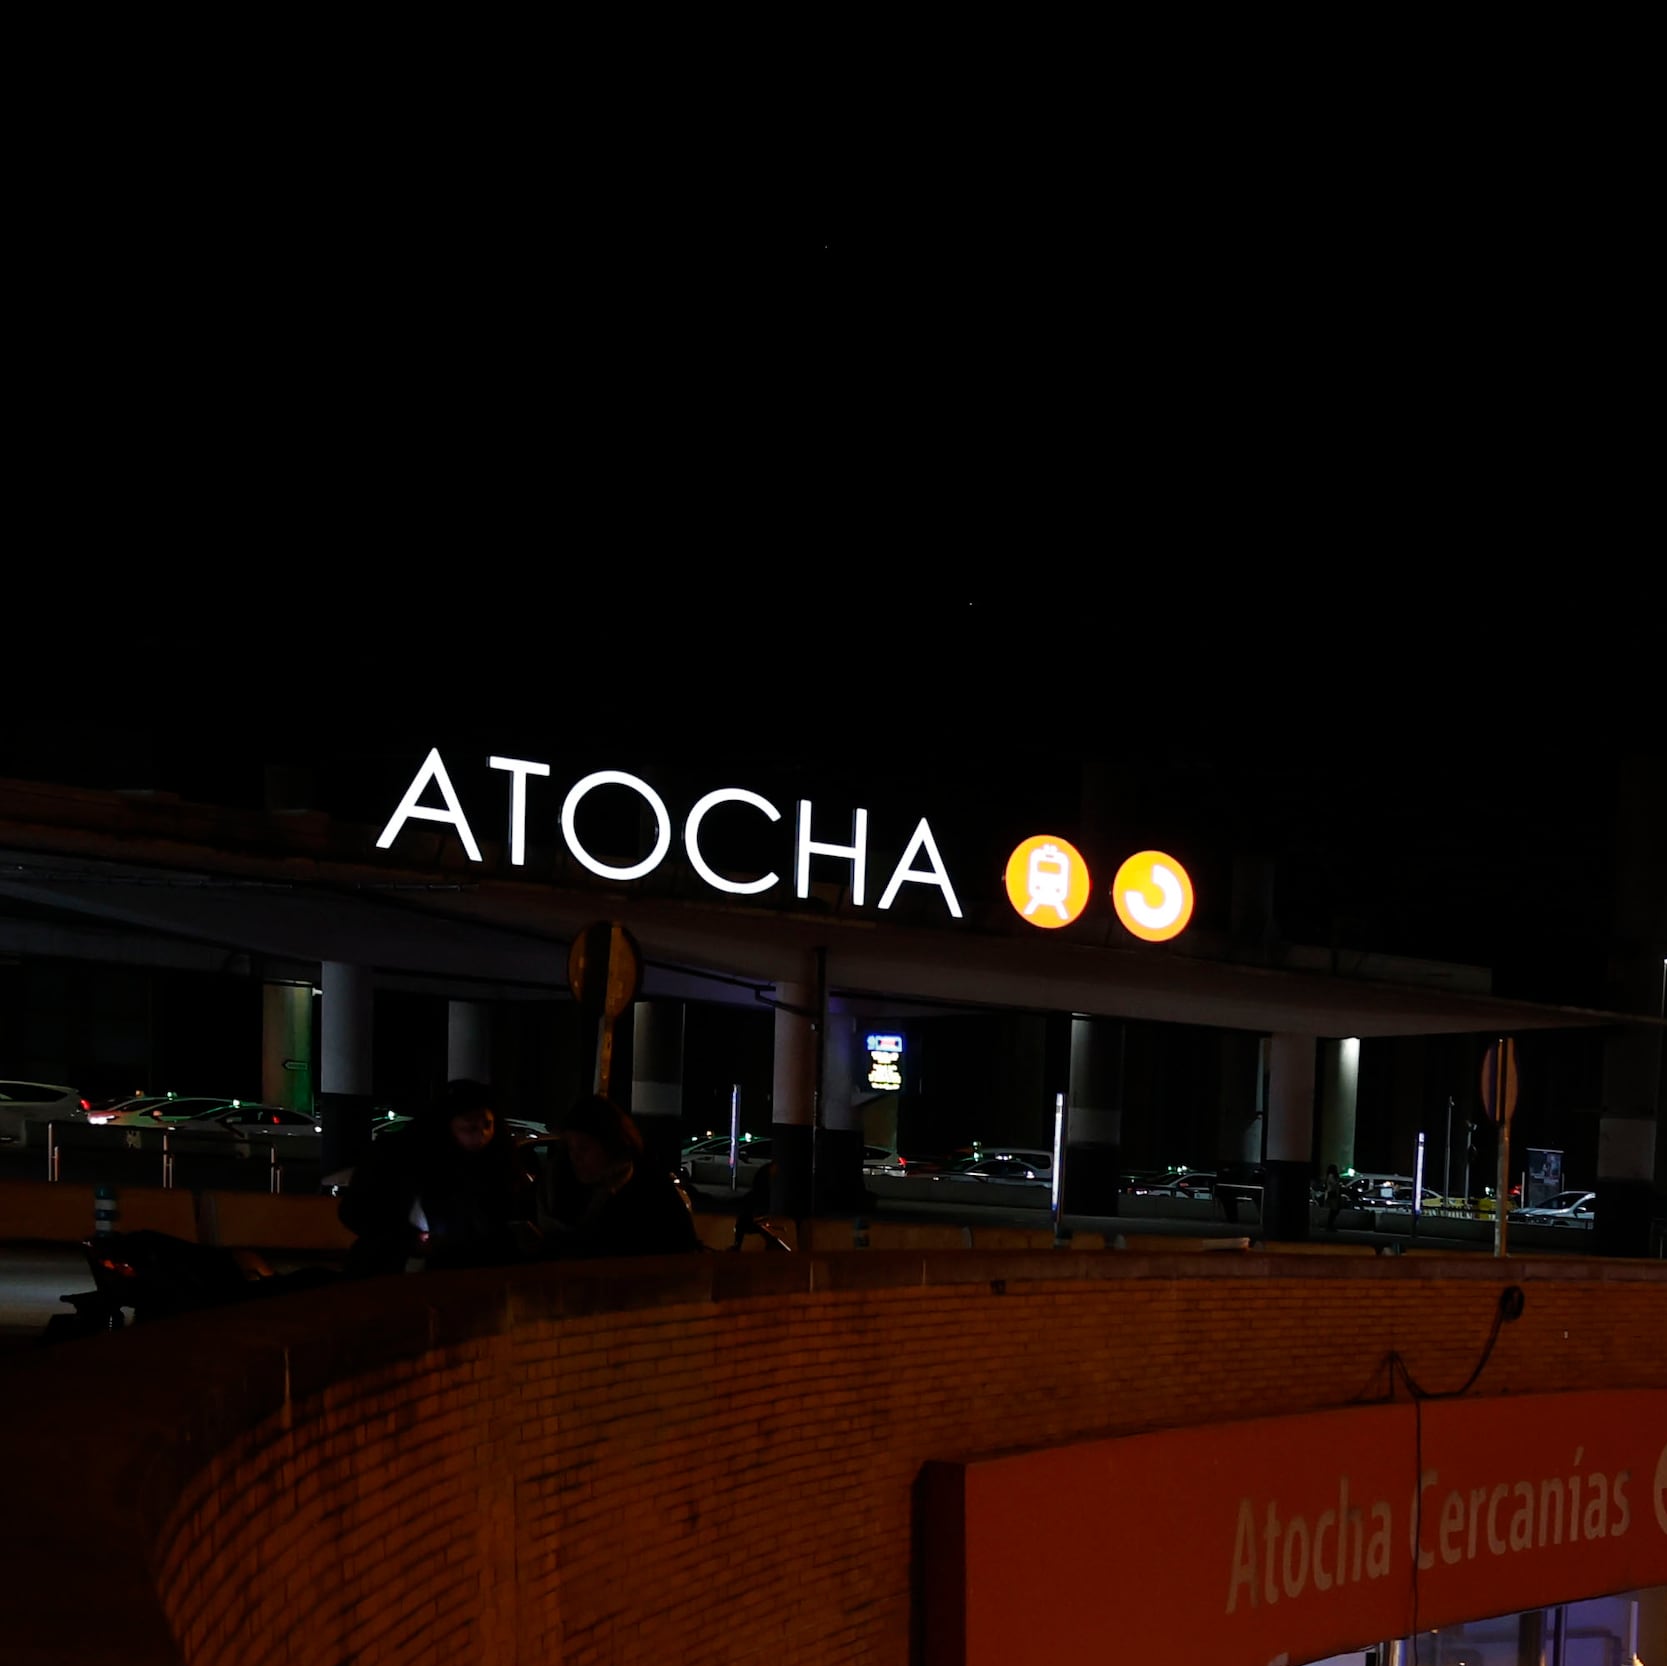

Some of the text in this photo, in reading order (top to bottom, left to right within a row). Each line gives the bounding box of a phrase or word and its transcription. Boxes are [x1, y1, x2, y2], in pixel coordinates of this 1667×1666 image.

[376, 746, 964, 919] ATOCHA
[1225, 1446, 1632, 1614] Atocha Cercanías
